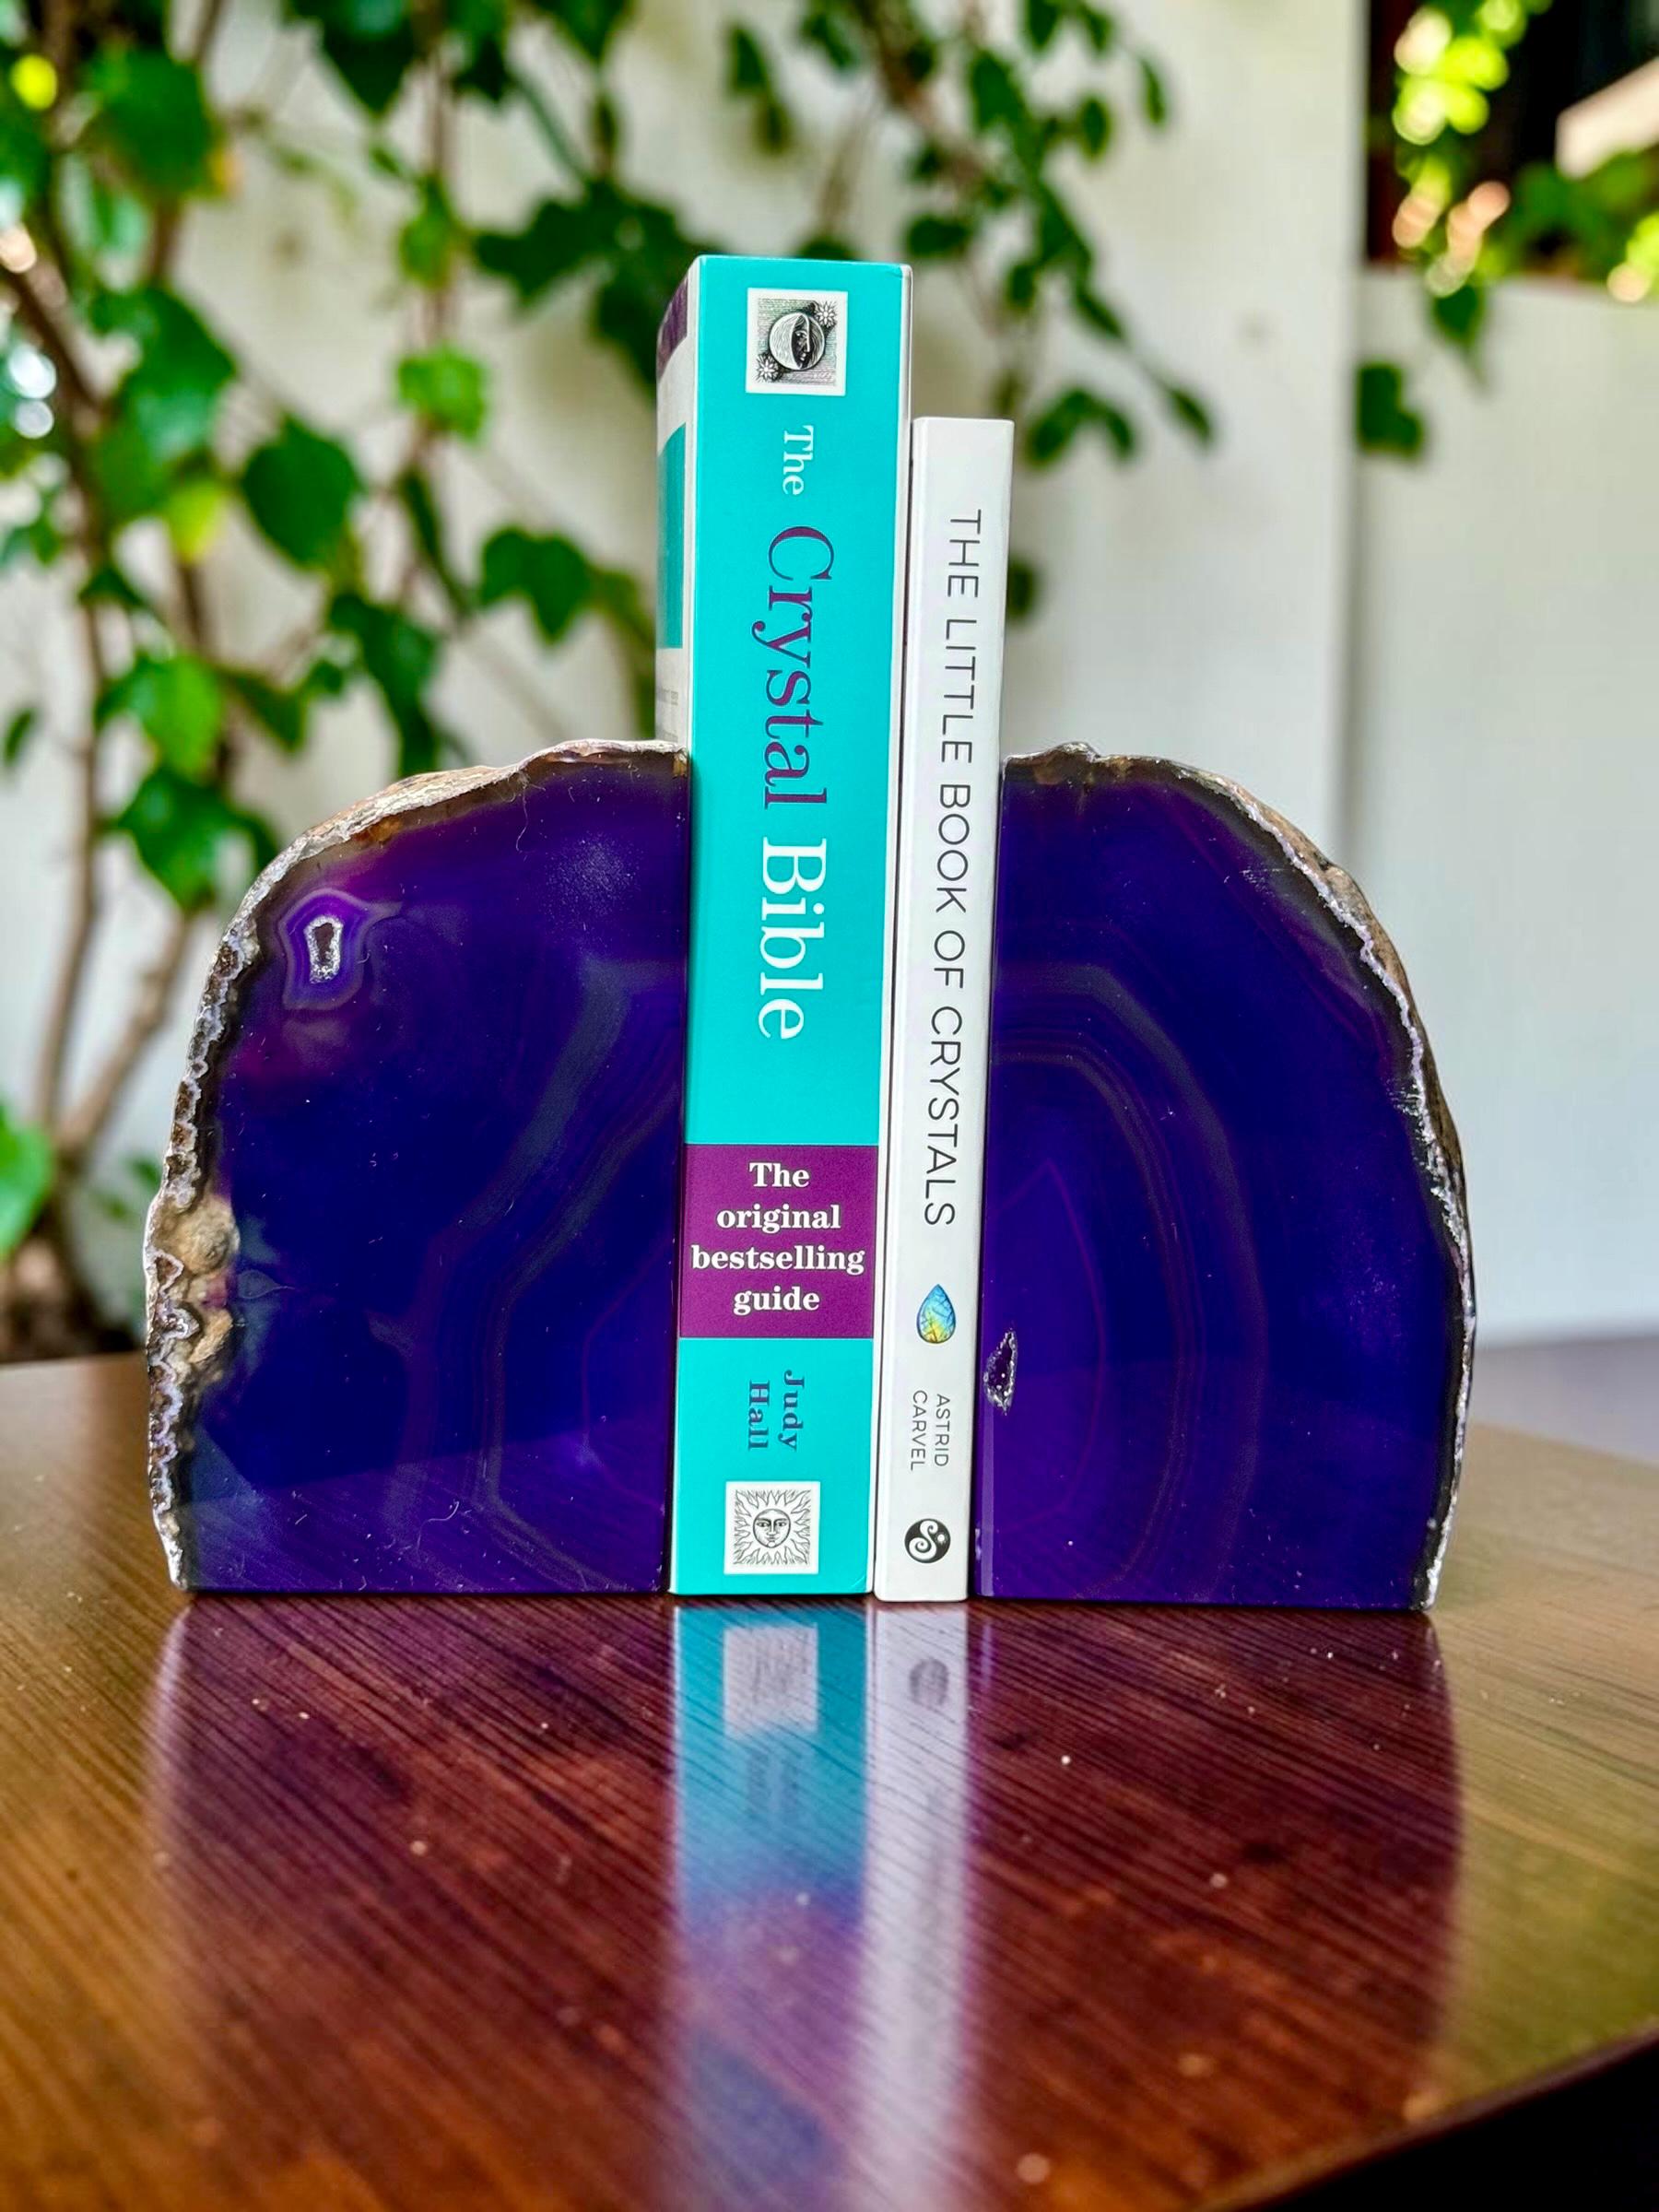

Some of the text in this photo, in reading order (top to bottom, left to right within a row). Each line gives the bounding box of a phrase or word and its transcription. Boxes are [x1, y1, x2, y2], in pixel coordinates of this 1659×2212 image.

[751, 425, 835, 1041] The Crystal Bible
[924, 509, 982, 1226] THE LITTLE BOOK OF CRYSTALS
[748, 1162, 810, 1188] The
[716, 1203, 841, 1234] original
[690, 1244, 865, 1276] bestselling
[733, 1285, 820, 1316] guide
[747, 1381, 771, 1452] Hall
[777, 1369, 805, 1452] Judy
[910, 1389, 928, 1472] CARVEL
[934, 1393, 951, 1467] ASTRID
